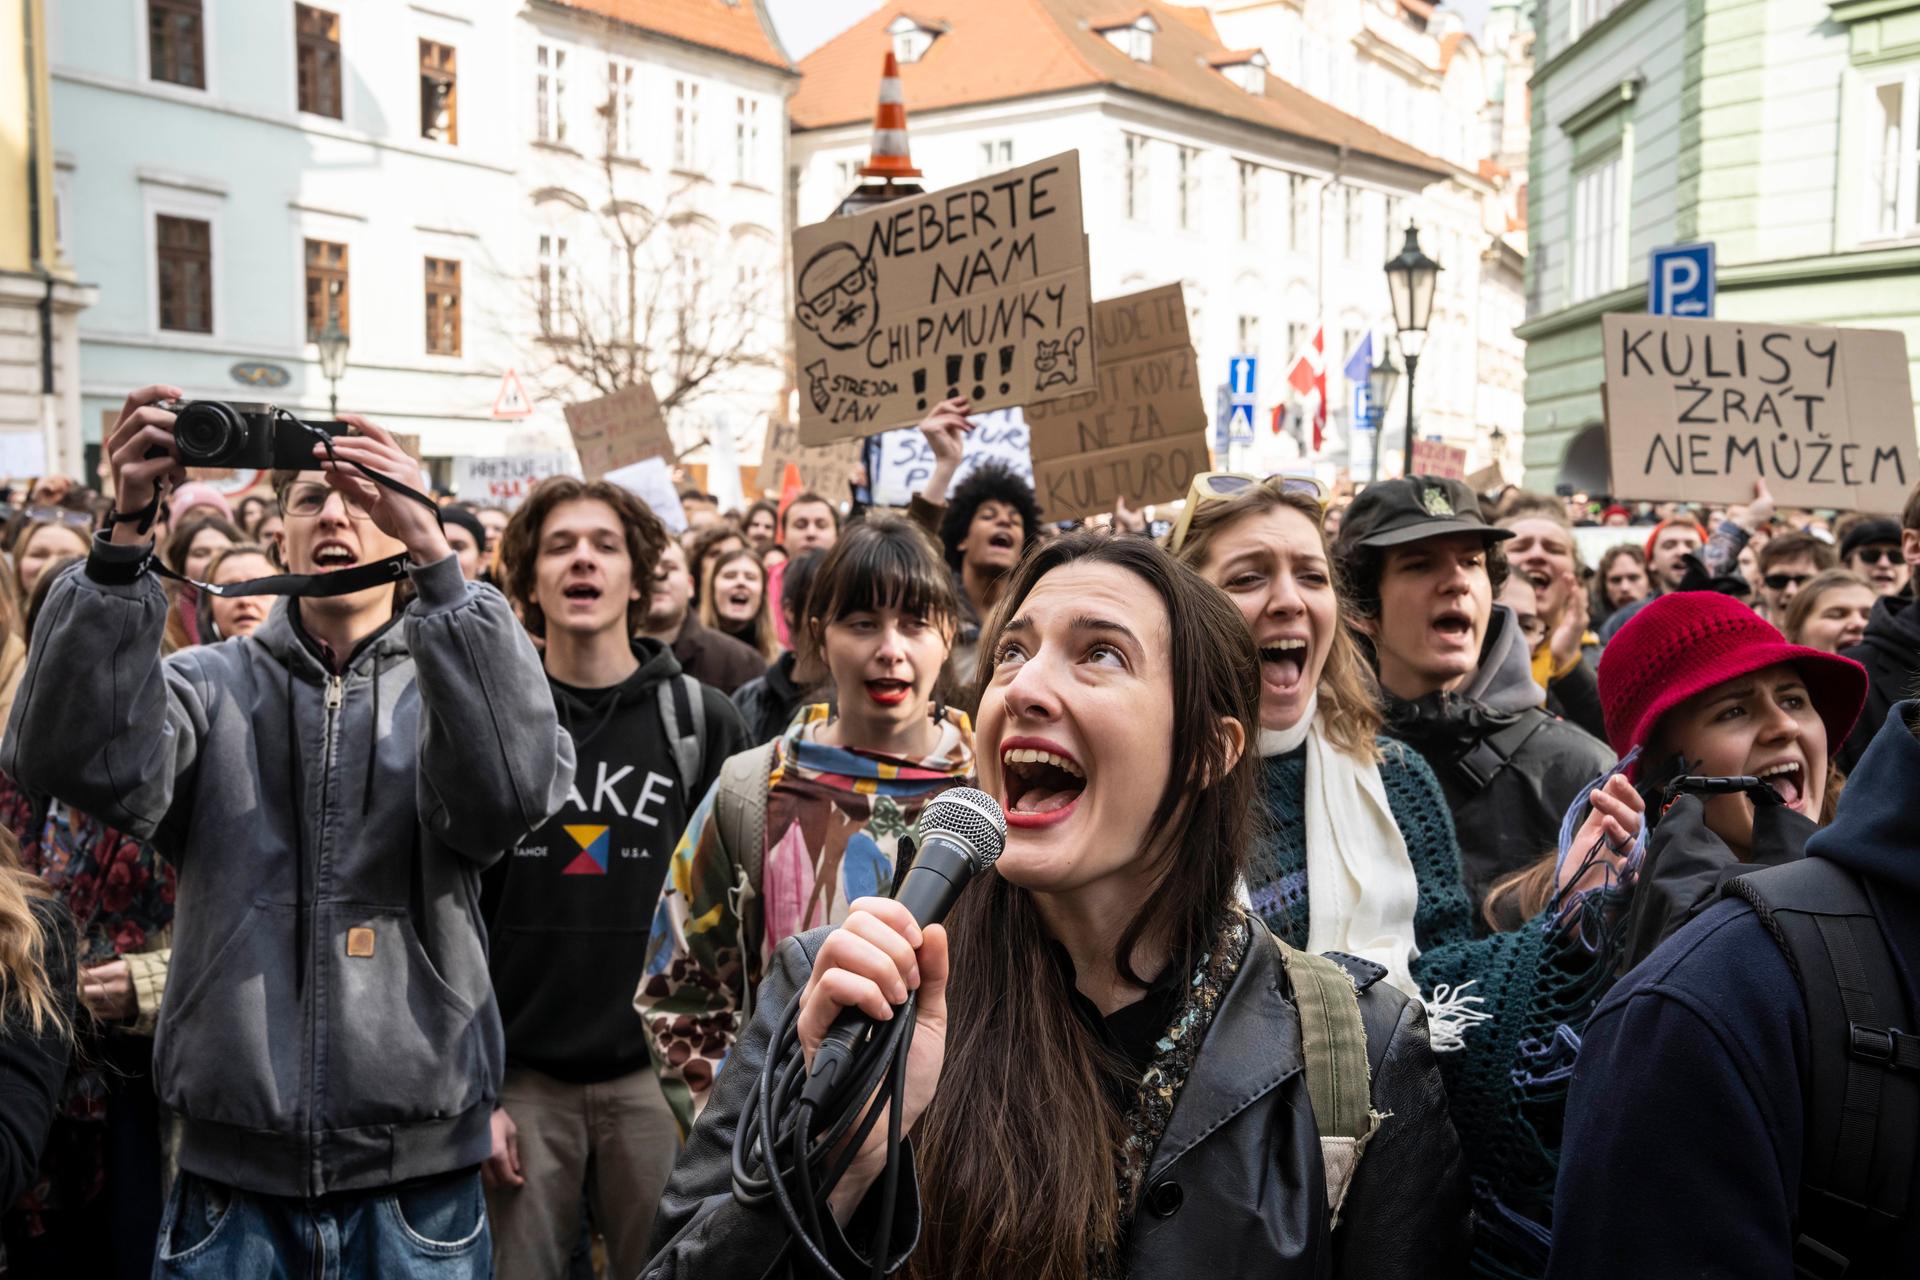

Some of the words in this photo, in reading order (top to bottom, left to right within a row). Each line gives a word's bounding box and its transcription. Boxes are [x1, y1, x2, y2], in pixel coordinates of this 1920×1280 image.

[865, 167, 1059, 260] NEBERTE
[930, 232, 1038, 304] NÁM
[1663, 256, 1701, 317] P
[867, 283, 1067, 369] CHIPMUNKY
[1097, 293, 1180, 349] UDETE
[1674, 378, 1825, 432] ŽRÁT
[1644, 432, 1906, 486] NEMŮŽEM
[566, 761, 674, 827] AKE
